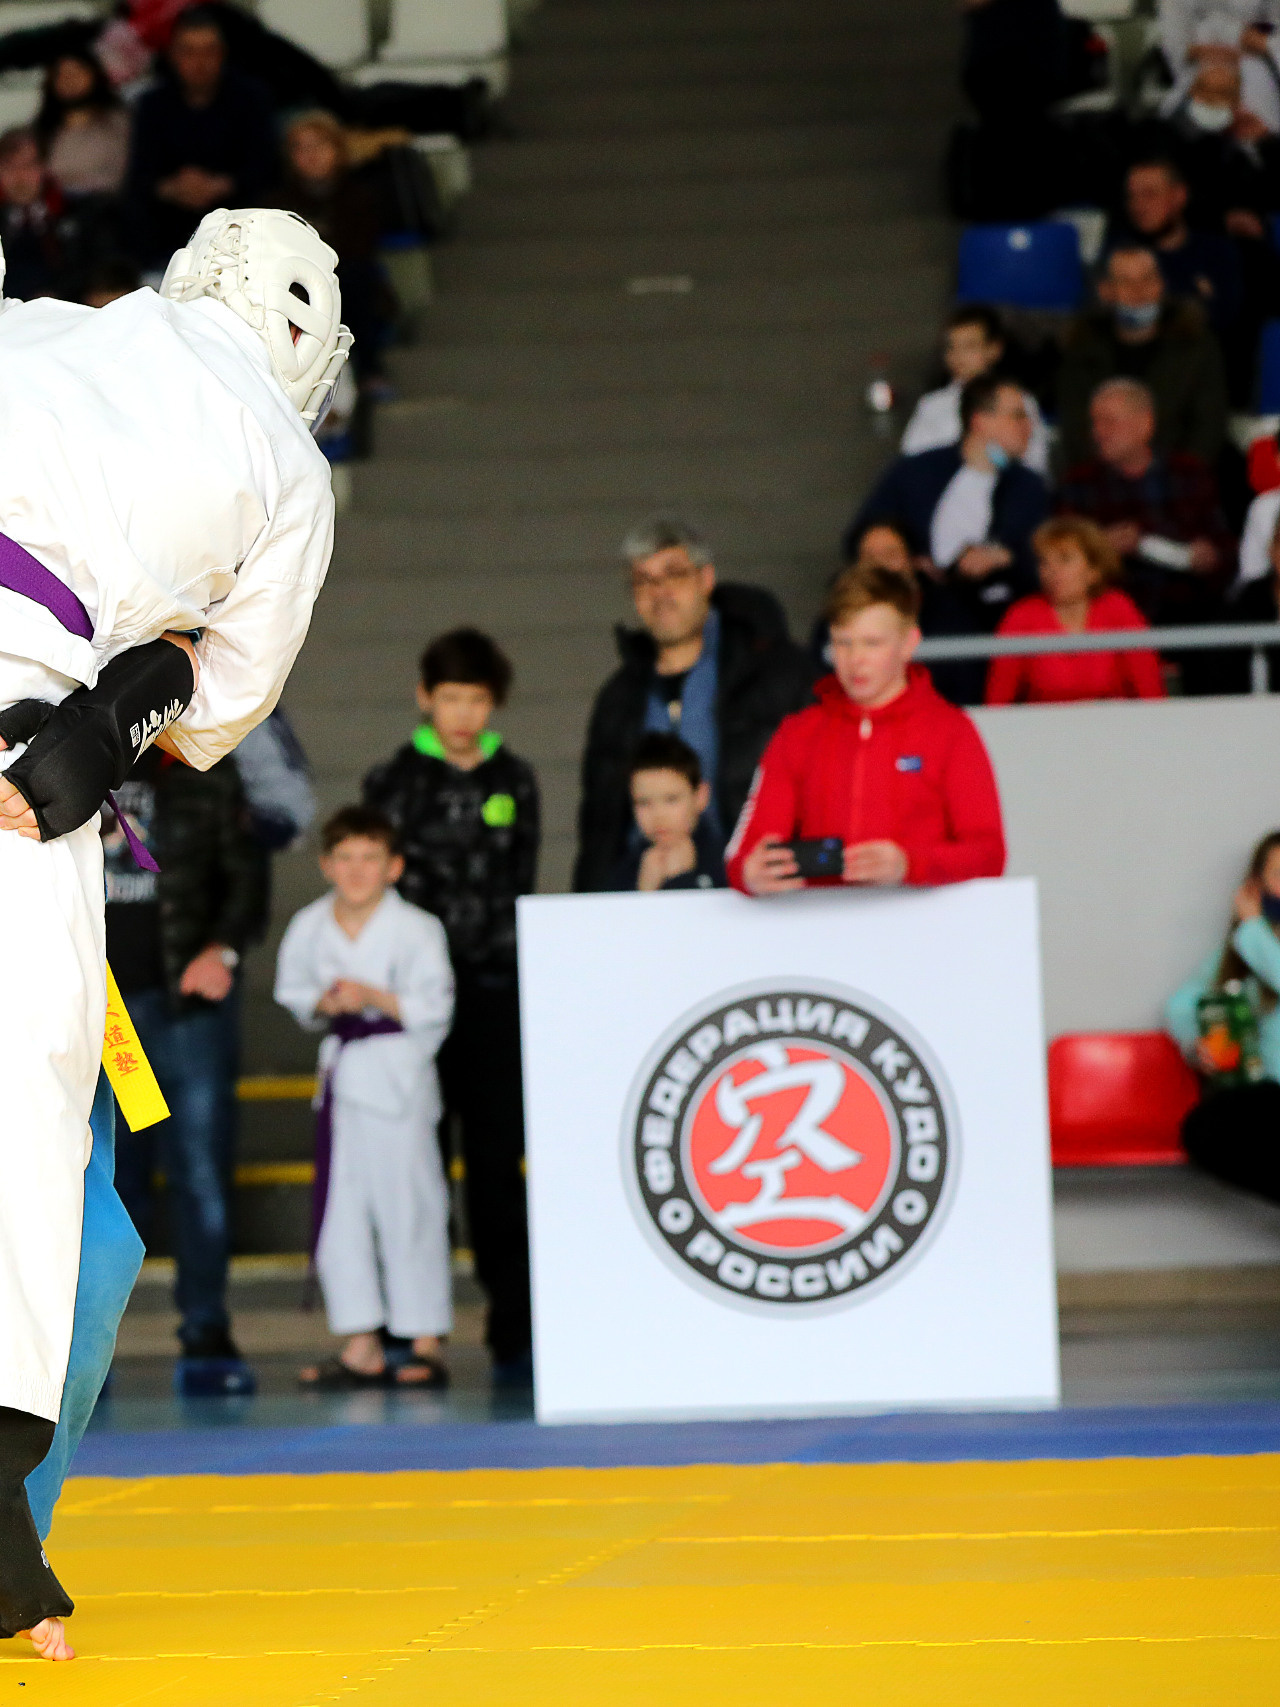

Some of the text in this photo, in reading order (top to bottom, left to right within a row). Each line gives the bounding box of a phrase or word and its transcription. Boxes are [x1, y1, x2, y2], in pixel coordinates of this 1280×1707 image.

[642, 998, 940, 1195] ФЕДЕРАЦИЯ КУДО
[686, 1224, 903, 1298] РОССИИ
